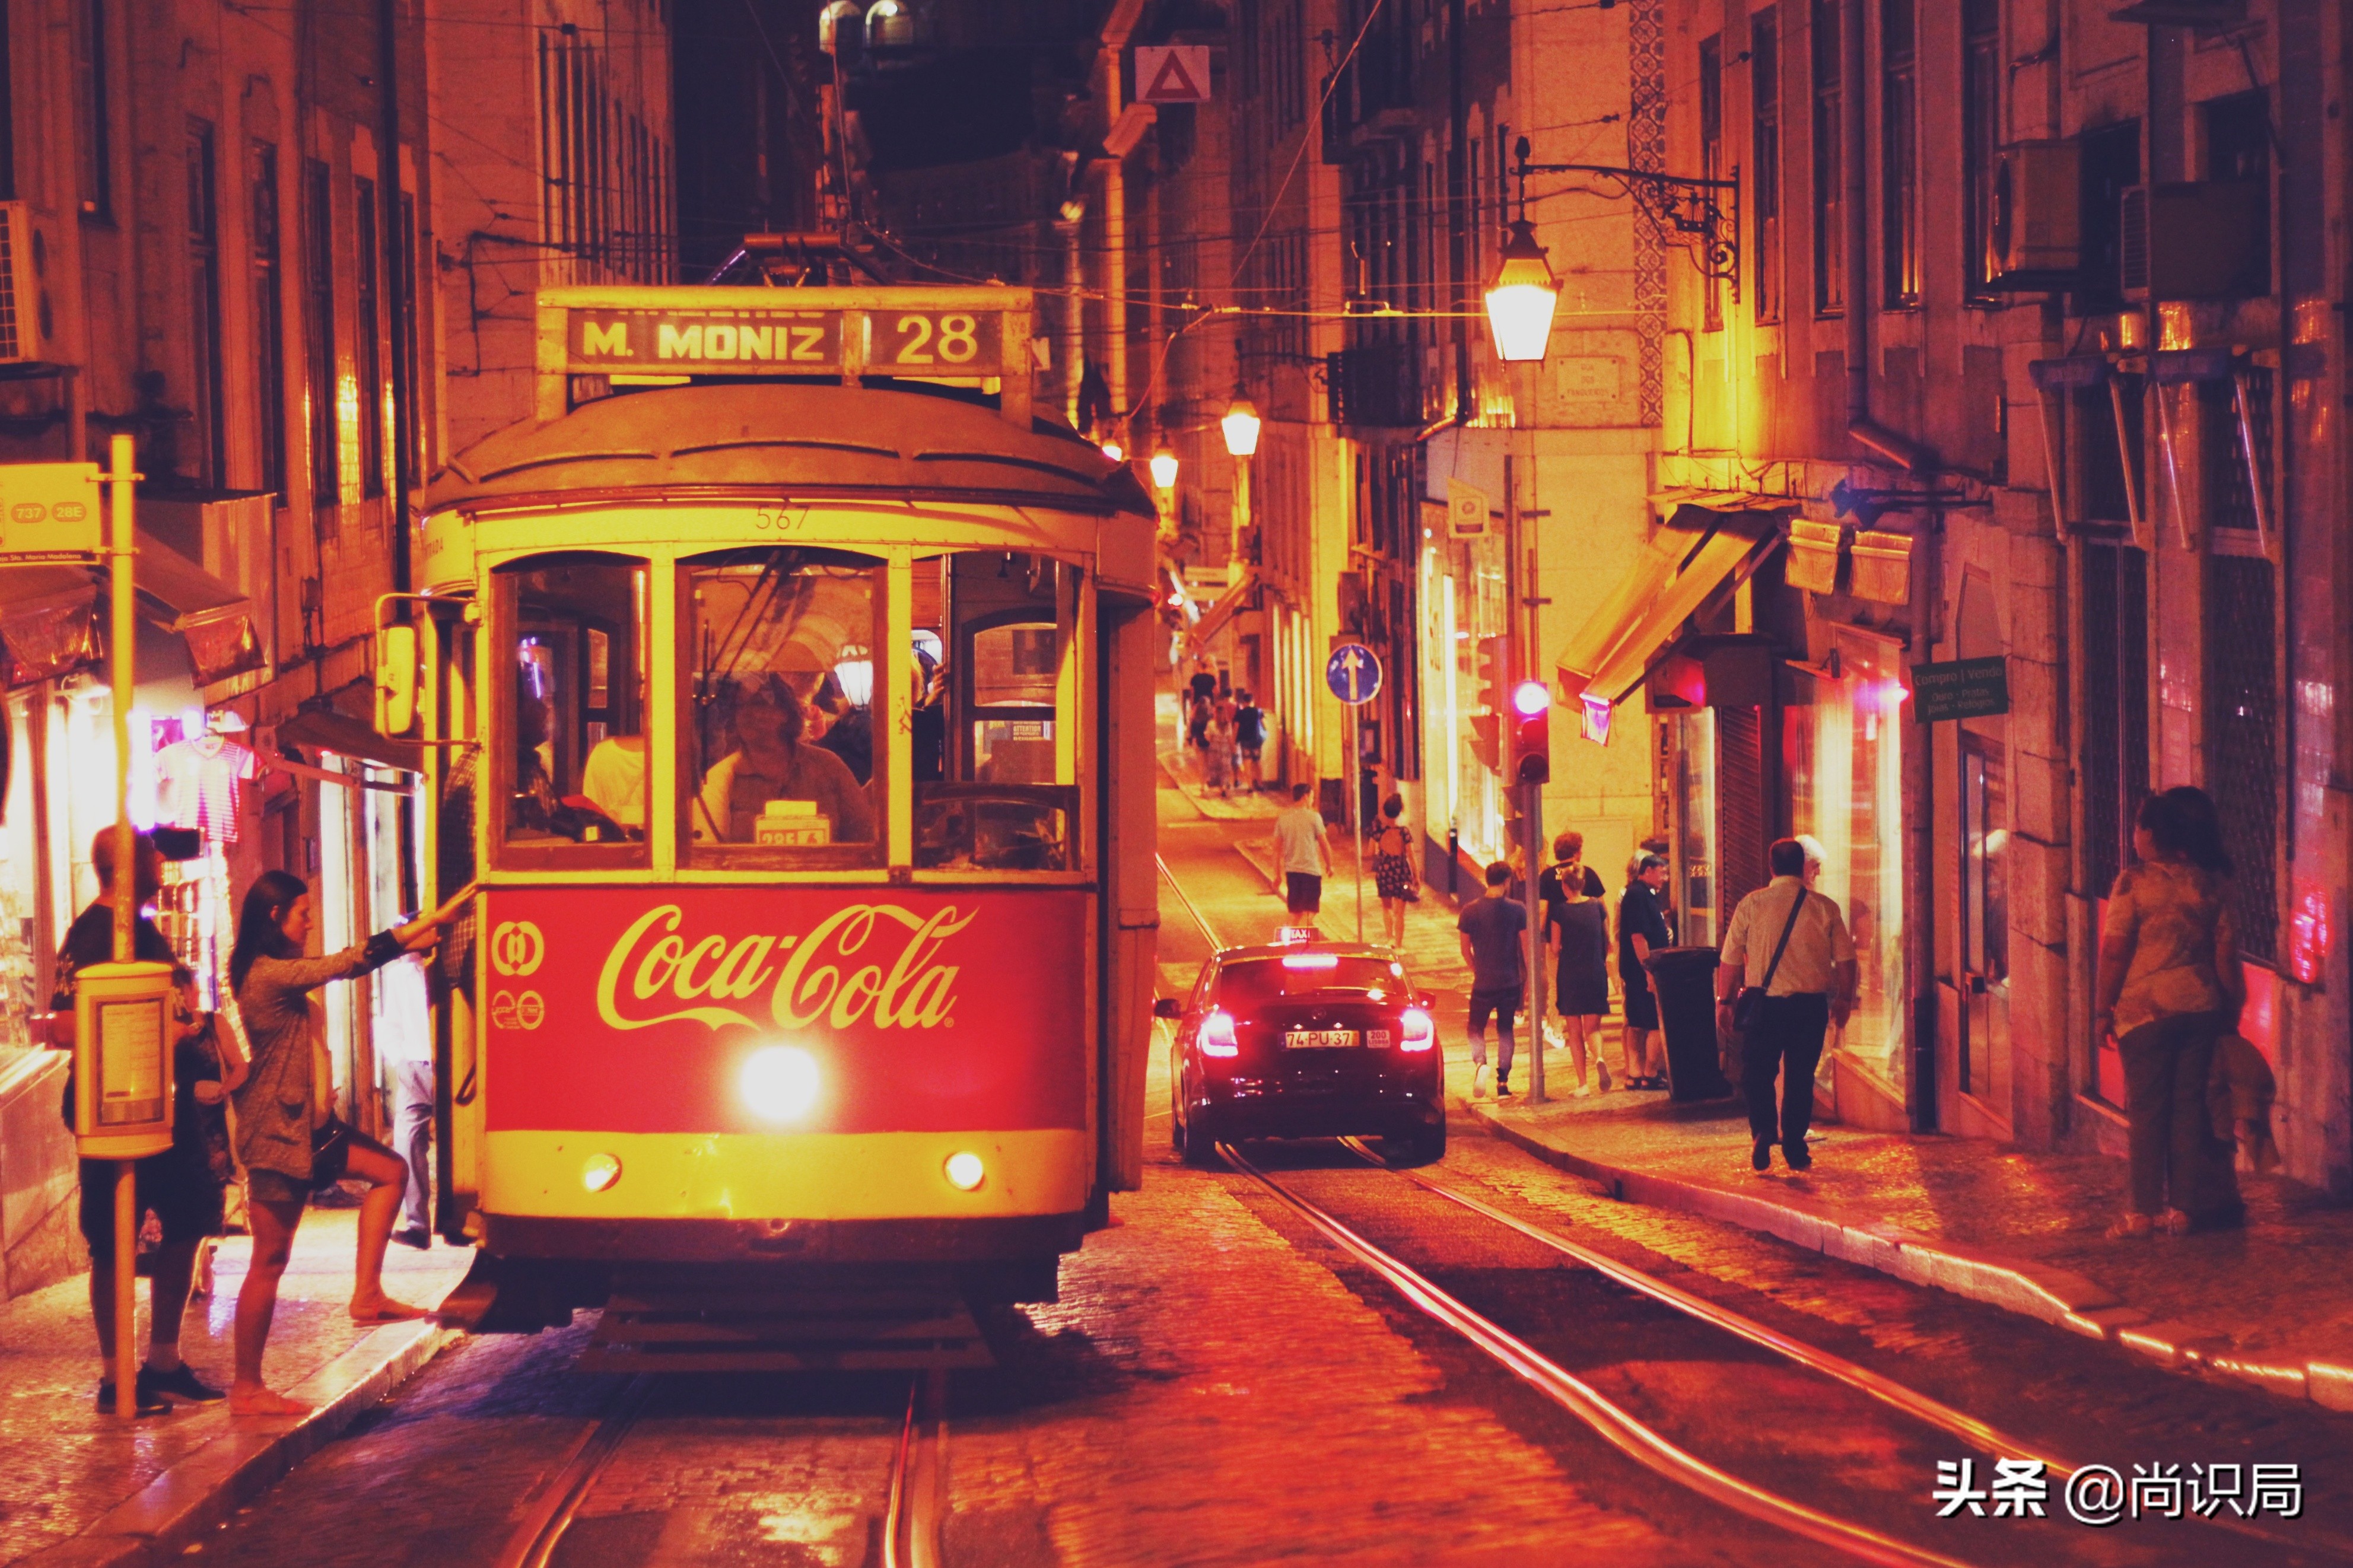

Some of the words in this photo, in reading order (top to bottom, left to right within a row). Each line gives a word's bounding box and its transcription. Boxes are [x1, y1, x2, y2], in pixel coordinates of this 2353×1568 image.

[583, 322, 634, 356] M.
[658, 325, 824, 360] MONIZ
[896, 314, 978, 364] 28
[16, 508, 42, 519] 737
[56, 506, 82, 518] 28E
[755, 504, 810, 529] 567
[1915, 673, 1957, 686] Compro
[1967, 666, 2002, 680] Vendo
[1932, 692, 1954, 702] Ouro
[1290, 928, 1311, 939] TAXI
[597, 904, 980, 1031] Coca-Cola
